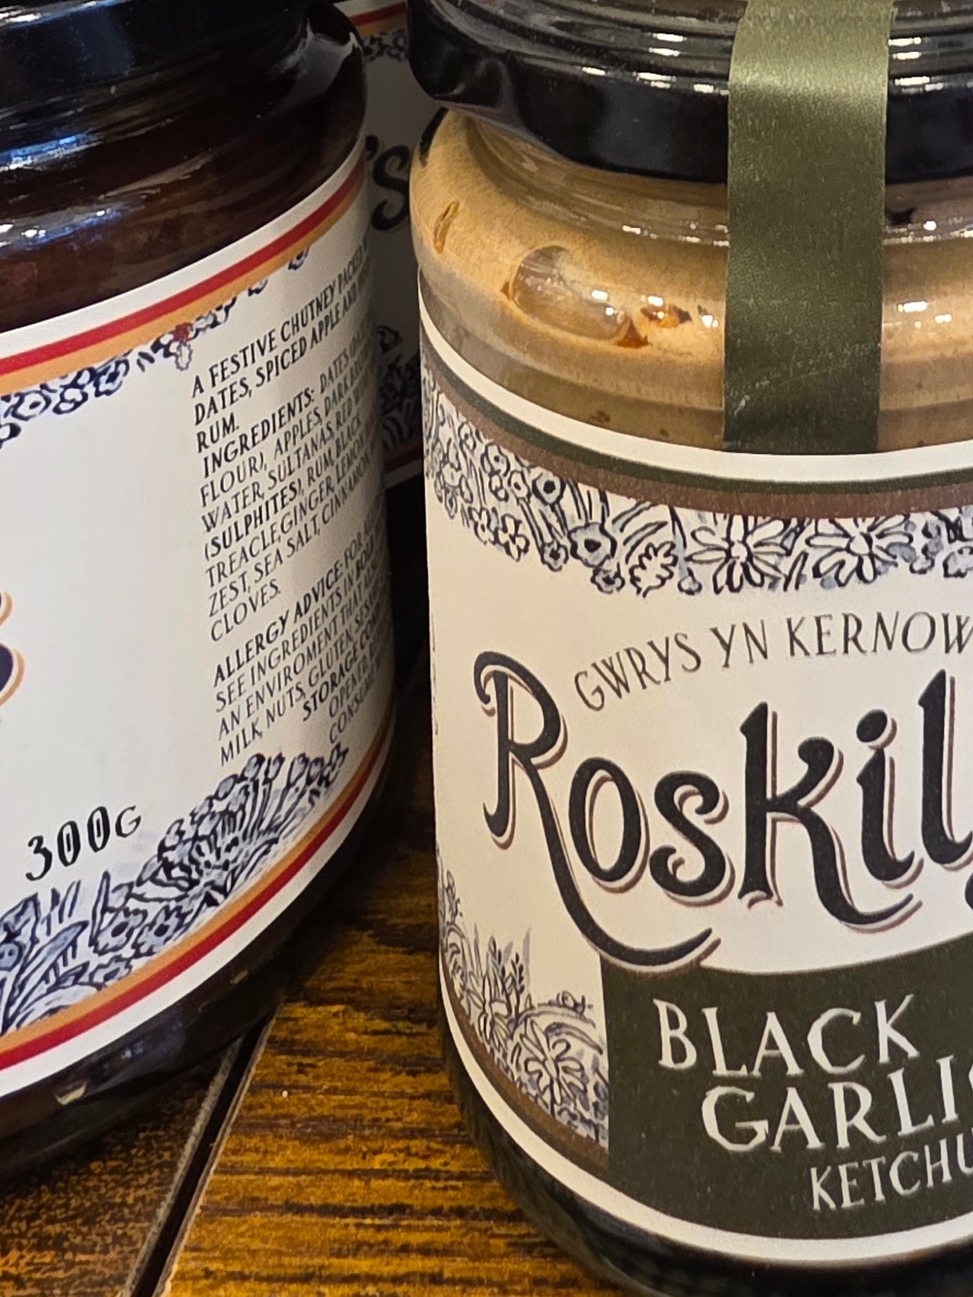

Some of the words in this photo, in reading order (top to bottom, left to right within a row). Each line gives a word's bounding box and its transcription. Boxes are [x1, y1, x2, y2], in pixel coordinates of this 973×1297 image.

[191, 375, 205, 399] A
[208, 329, 277, 388] FESTIVE
[281, 278, 336, 343] CHUTNEY
[194, 381, 252, 426] DATES,
[255, 338, 307, 388] SPICED
[310, 301, 341, 350] APPLE
[196, 411, 240, 453] RUM.
[203, 387, 315, 478] INGREDIENTS:
[320, 348, 349, 394] DATES
[200, 452, 267, 508] FLOUR),
[201, 480, 265, 533] WATER,
[208, 575, 251, 617] ZEST,
[254, 549, 283, 583] SEA
[286, 514, 320, 558] SALT,
[210, 579, 280, 642] CLOVES.
[213, 609, 289, 687] ALLERGY
[215, 676, 247, 713] SEE
[251, 586, 342, 686] INGREDIENTS
[218, 706, 241, 741] AN
[246, 615, 339, 717] ENVIROMENT
[302, 642, 358, 722] STORAGE
[574, 632, 702, 711] GWRYS
[710, 619, 769, 669] YN
[220, 719, 263, 766] MILK,
[25, 805, 142, 882] 300G
[652, 993, 920, 1077] BLACK
